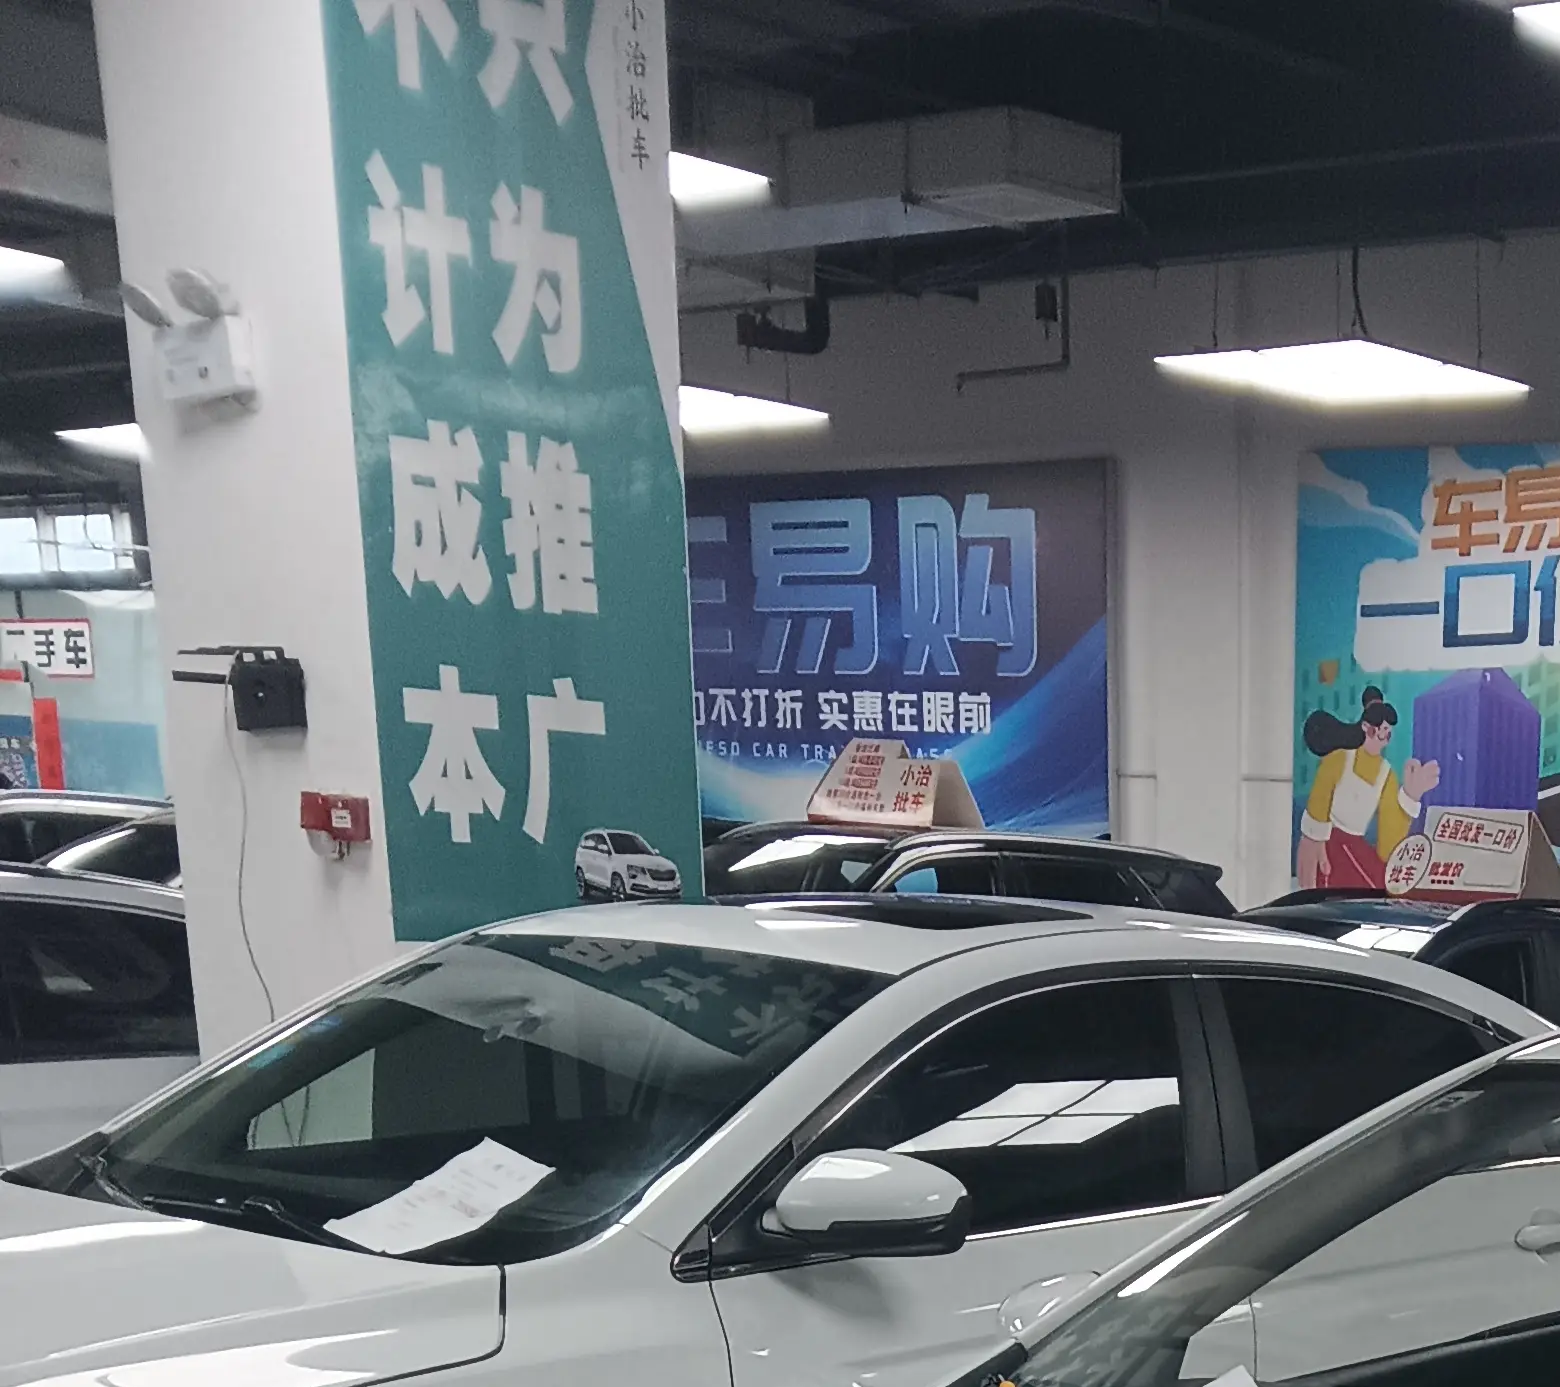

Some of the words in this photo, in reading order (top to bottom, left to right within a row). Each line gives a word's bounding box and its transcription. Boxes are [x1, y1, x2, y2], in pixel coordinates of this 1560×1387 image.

[818, 690, 992, 735] 实惠在眼前
[752, 742, 788, 758] CAR
[1437, 818, 1517, 850] 全国批发一口价
